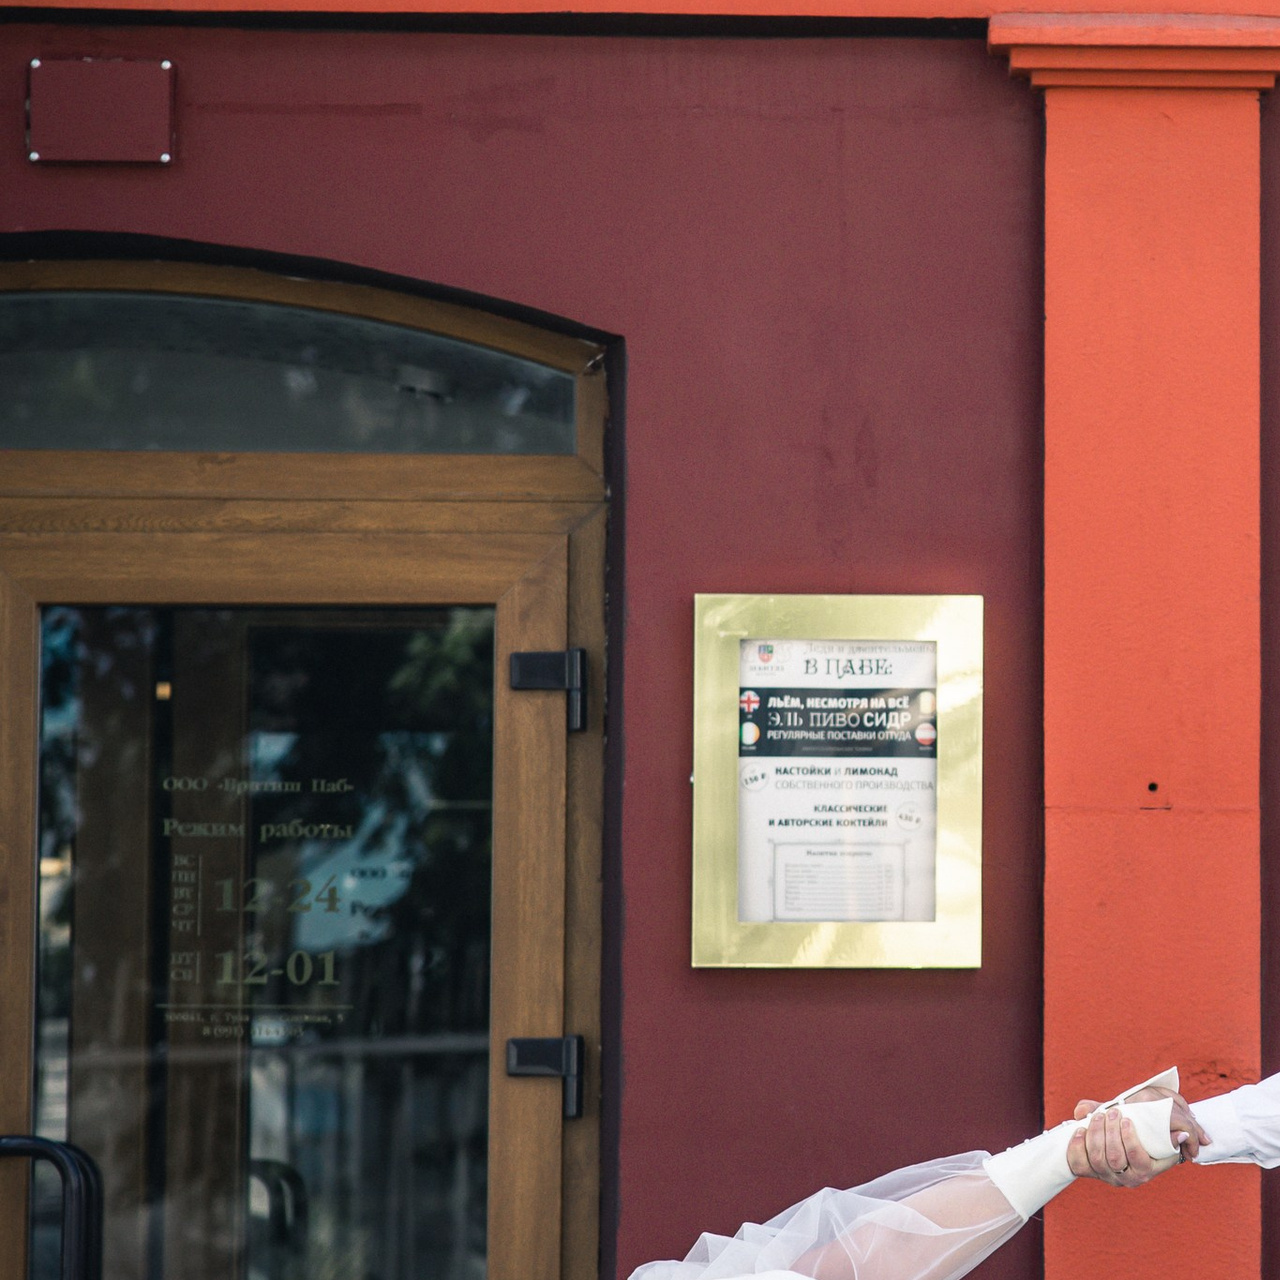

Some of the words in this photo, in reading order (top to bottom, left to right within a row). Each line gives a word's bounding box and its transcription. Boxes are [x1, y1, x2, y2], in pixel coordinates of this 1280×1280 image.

[804, 658, 818, 675] В
[767, 695, 804, 710] ЛЬЁМ,
[806, 697, 868, 709] НЕСМОТРЯ
[870, 697, 886, 709] НА
[888, 695, 910, 709] ВСЁ
[809, 712, 860, 728] ПИВО
[863, 711, 912, 730] СИДР
[767, 729, 826, 740] РЕГУЛЯРНЫЕ
[827, 730, 876, 740] ПОСТАВКИ
[877, 730, 912, 742] ОТТУДА
[775, 765, 832, 776] НАСТОЙКИ
[844, 767, 899, 778] ЛИМОНАД
[163, 777, 208, 792] ООО
[775, 779, 854, 790] СОБСТВЕННОГО
[855, 780, 935, 791] ПРОИЗВОДСТВА
[814, 804, 888, 813] КЛАССИЧЕСКИЕ
[769, 819, 776, 827] И
[778, 819, 833, 827] АВТОРСКИЕ
[836, 817, 888, 827] КОКТЕЙЛИ
[163, 819, 247, 837] Режим
[260, 819, 354, 843] работы
[215, 949, 341, 986] 12-01
